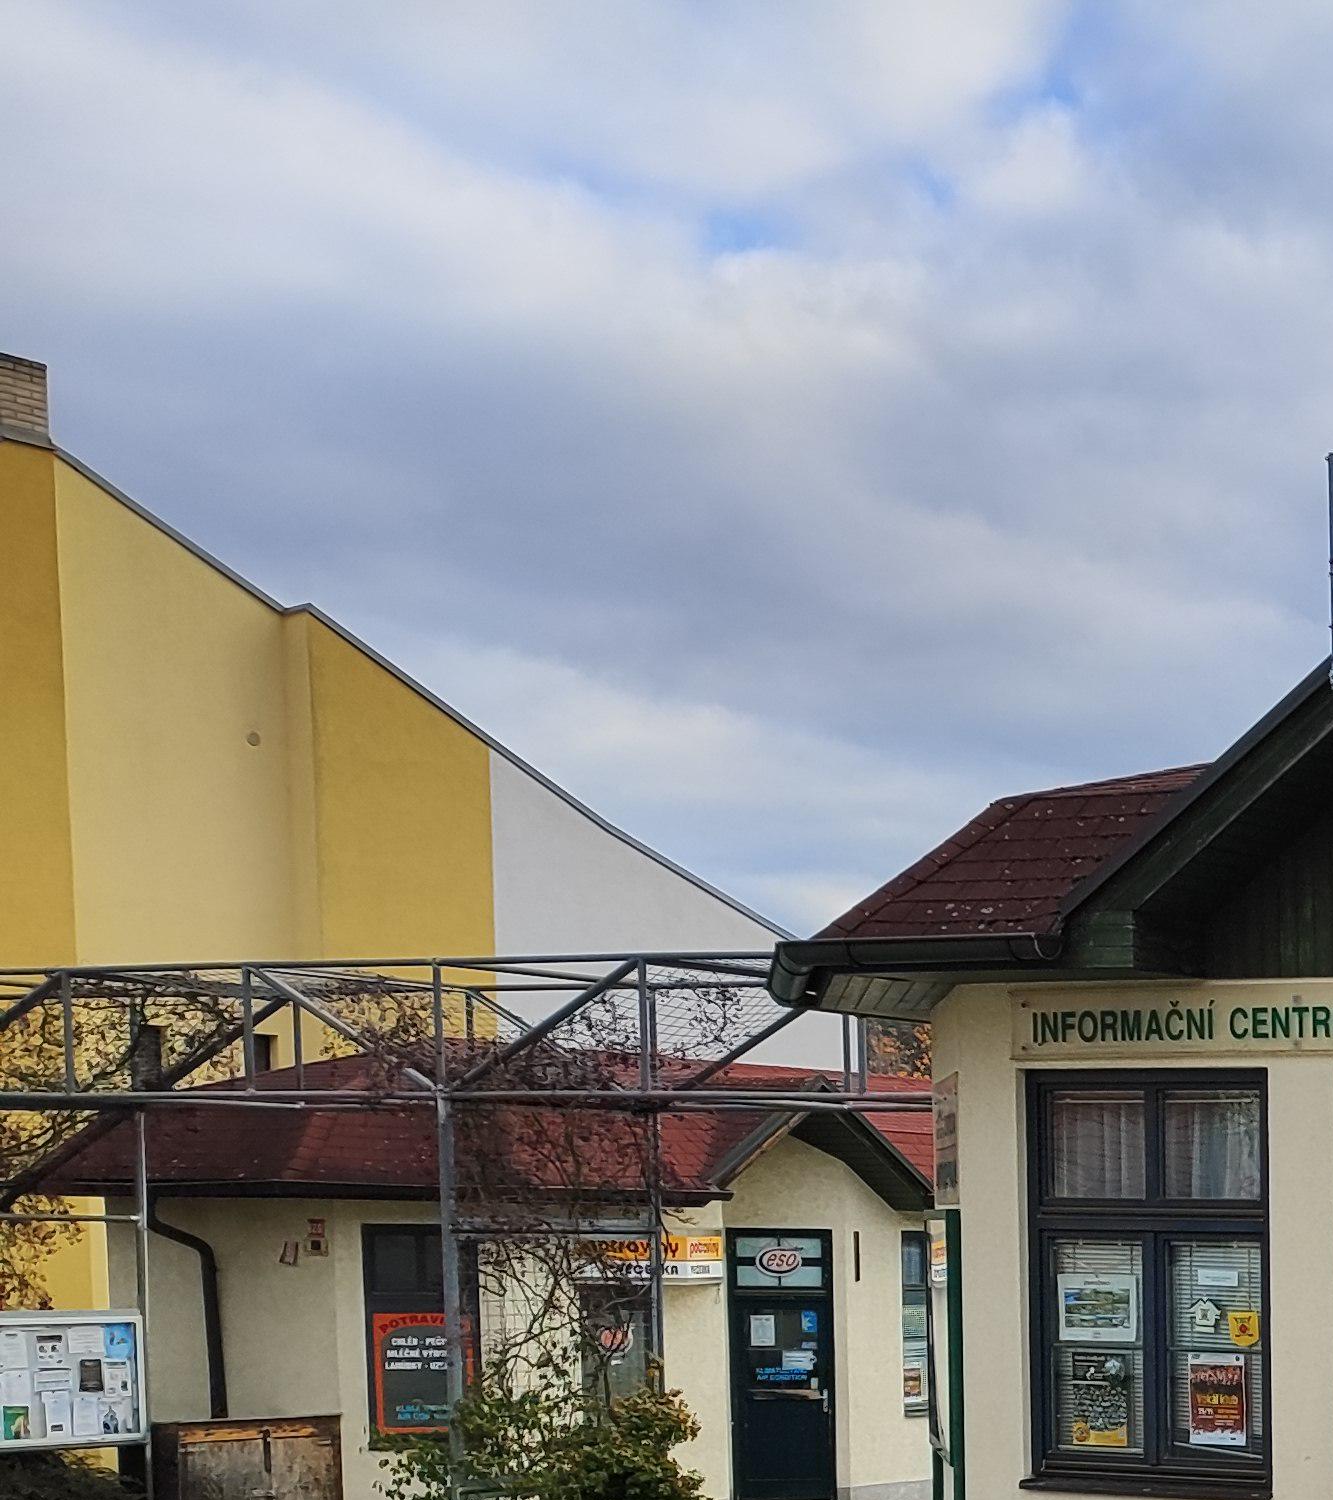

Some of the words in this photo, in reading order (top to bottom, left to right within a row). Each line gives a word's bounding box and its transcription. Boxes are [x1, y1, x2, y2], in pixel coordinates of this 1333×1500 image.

[1032, 1000, 1215, 1043] INFORMAČNÍ
[766, 1253, 797, 1267] eso
[379, 1314, 447, 1334] POTRAVI
